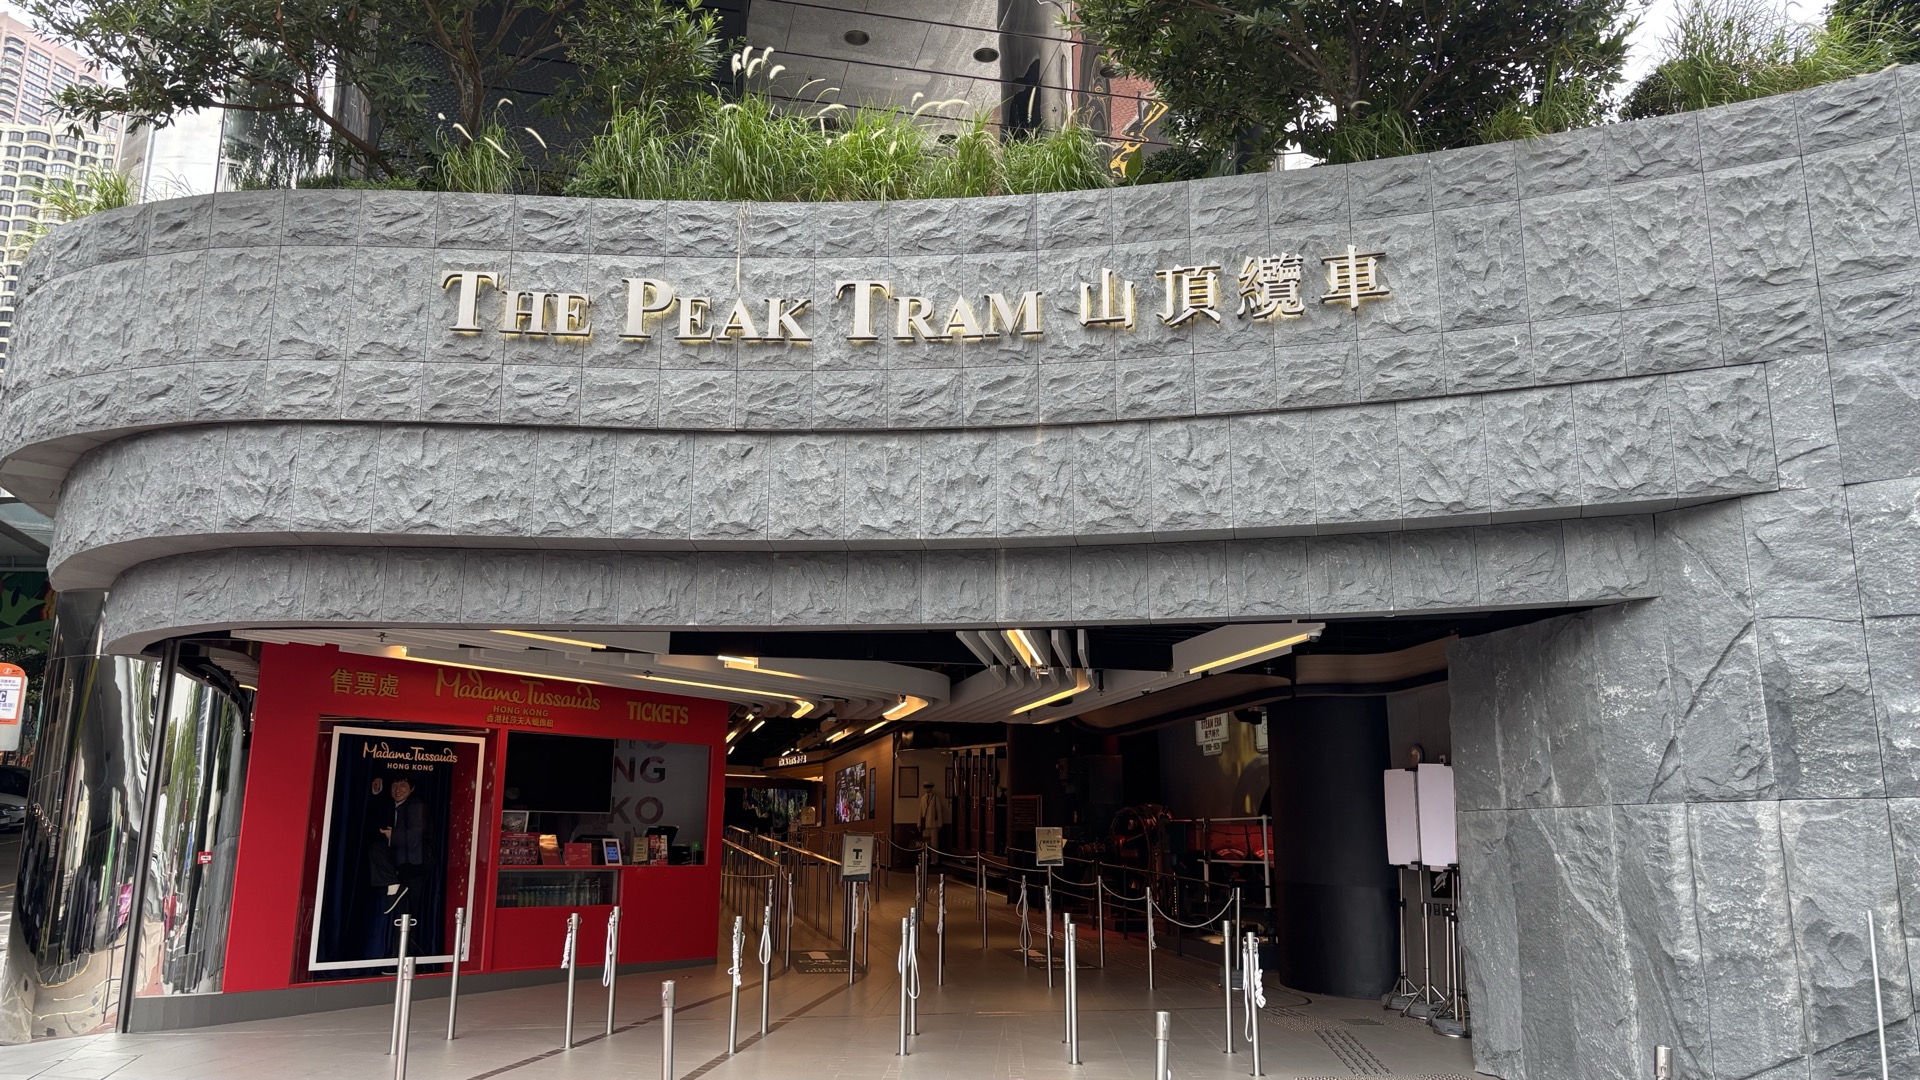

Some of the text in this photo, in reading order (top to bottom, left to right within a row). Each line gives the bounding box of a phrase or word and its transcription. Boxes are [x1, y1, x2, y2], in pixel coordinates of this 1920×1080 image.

[441, 244, 1391, 343] THE PEAK TRAM 山頂纜車
[331, 668, 400, 698] 售票處
[434, 667, 601, 711] Madame Tussauds
[493, 704, 549, 717] HONG KONG
[626, 700, 689, 725] TICKETS
[362, 742, 458, 763] Madame Tussauds
[387, 762, 410, 770] HONG
